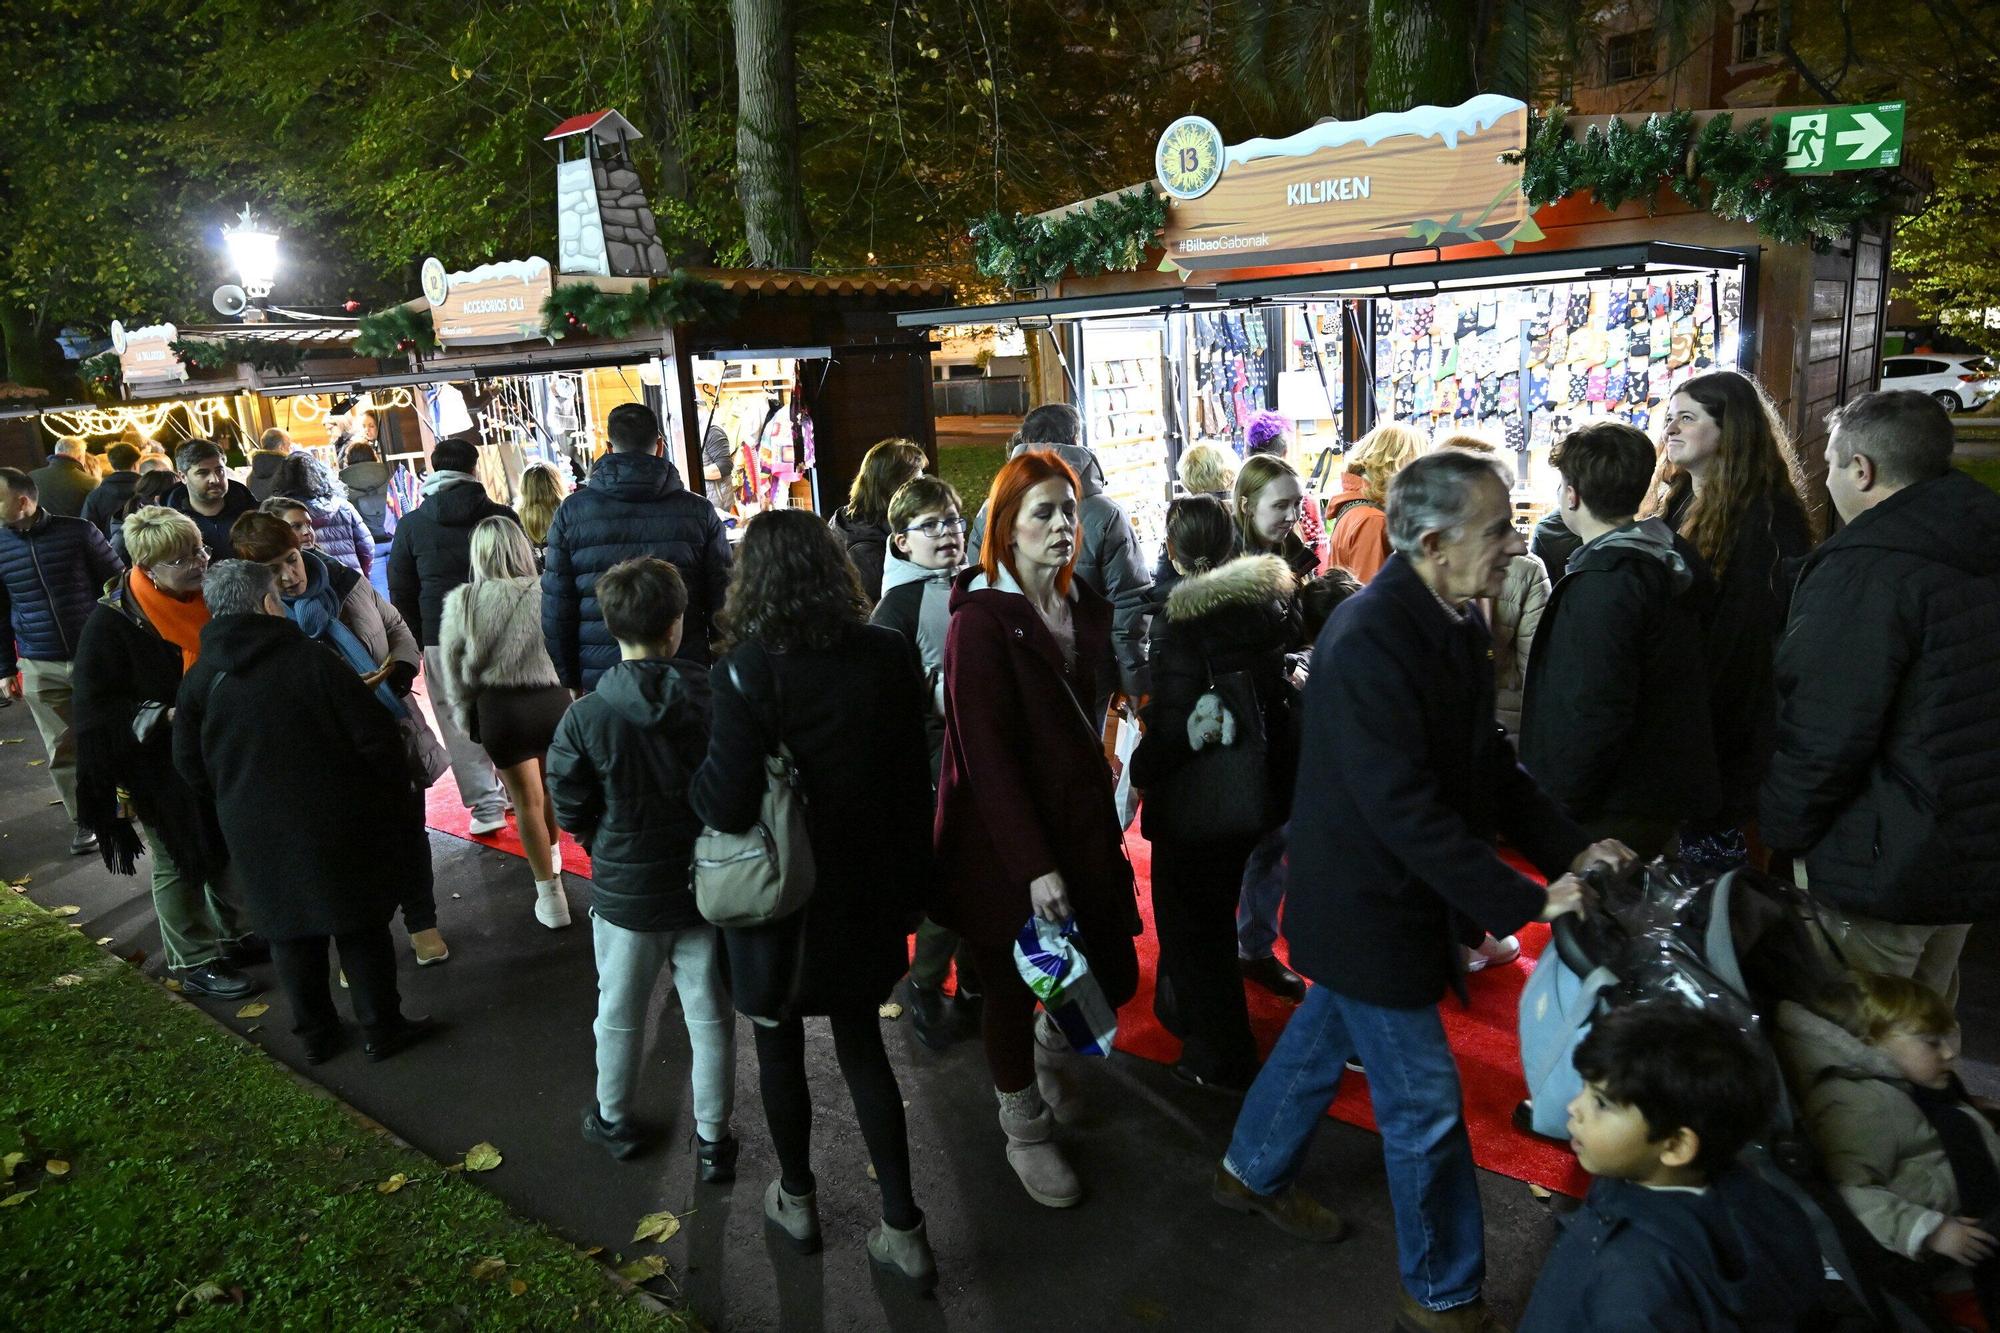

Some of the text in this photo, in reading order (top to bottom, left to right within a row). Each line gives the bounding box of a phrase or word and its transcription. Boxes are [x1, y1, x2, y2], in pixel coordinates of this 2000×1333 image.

[1179, 147, 1199, 174] 13
[1287, 175, 1370, 206] KILIKEN
[1178, 232, 1269, 253] #BilbaoGabonak
[430, 275, 439, 290] 12
[463, 298, 508, 315] ACCESORIOS
